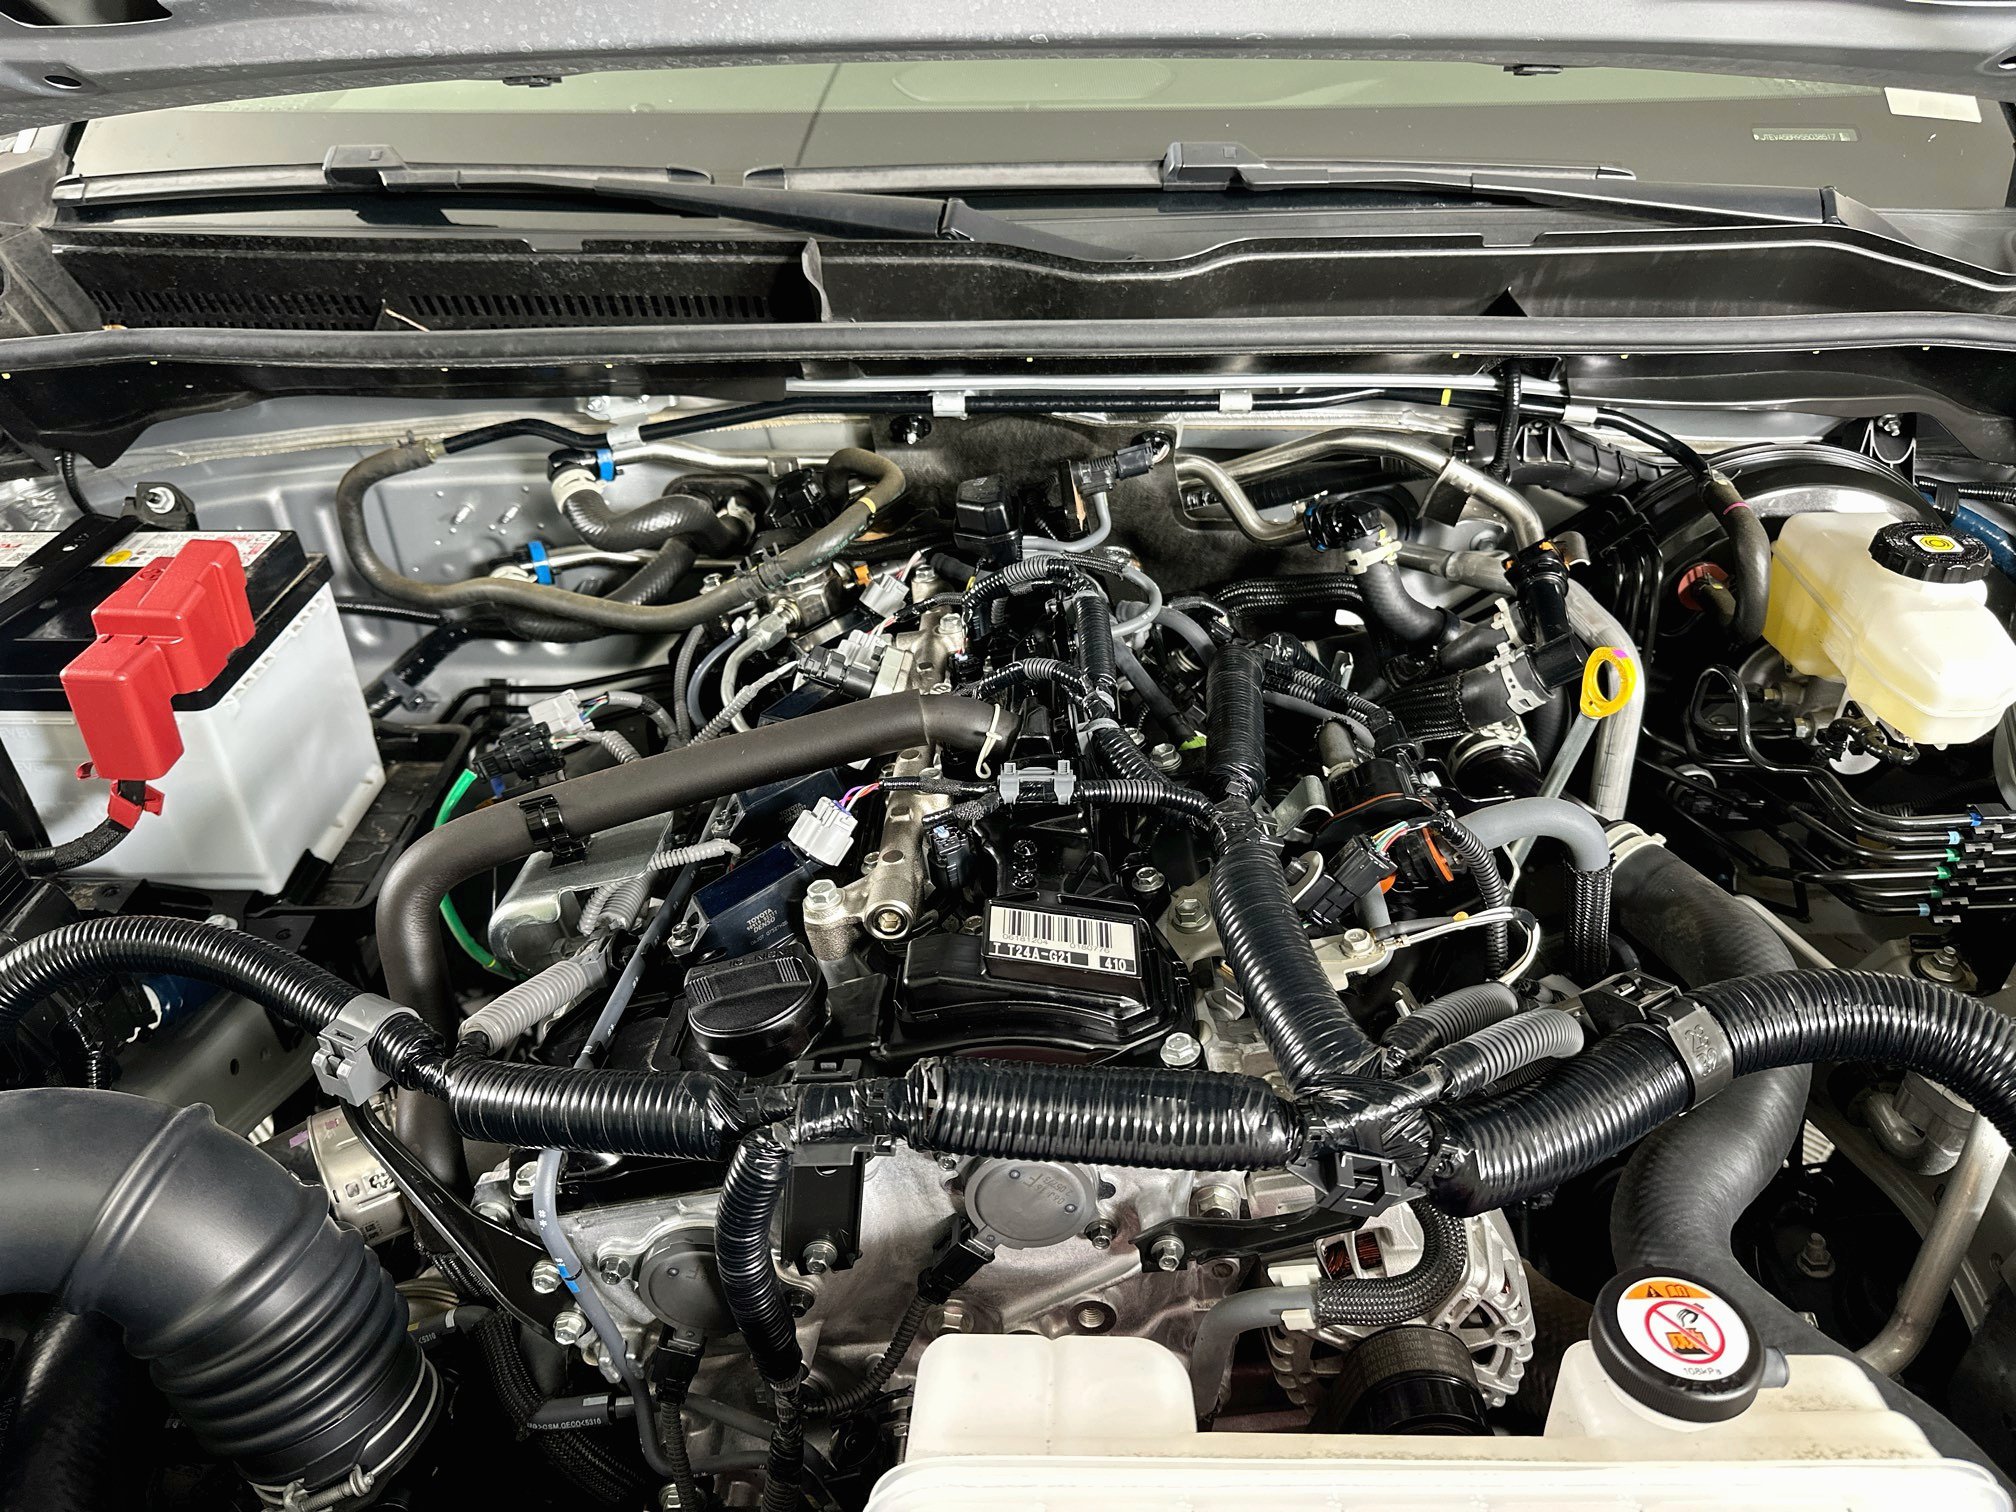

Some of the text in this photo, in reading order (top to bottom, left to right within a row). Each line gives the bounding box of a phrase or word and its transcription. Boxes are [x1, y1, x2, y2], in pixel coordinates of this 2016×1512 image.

[747, 908, 773, 924] TOYOTA
[753, 917, 776, 933] DENSO
[993, 942, 1127, 971] T T24A-G21 410
